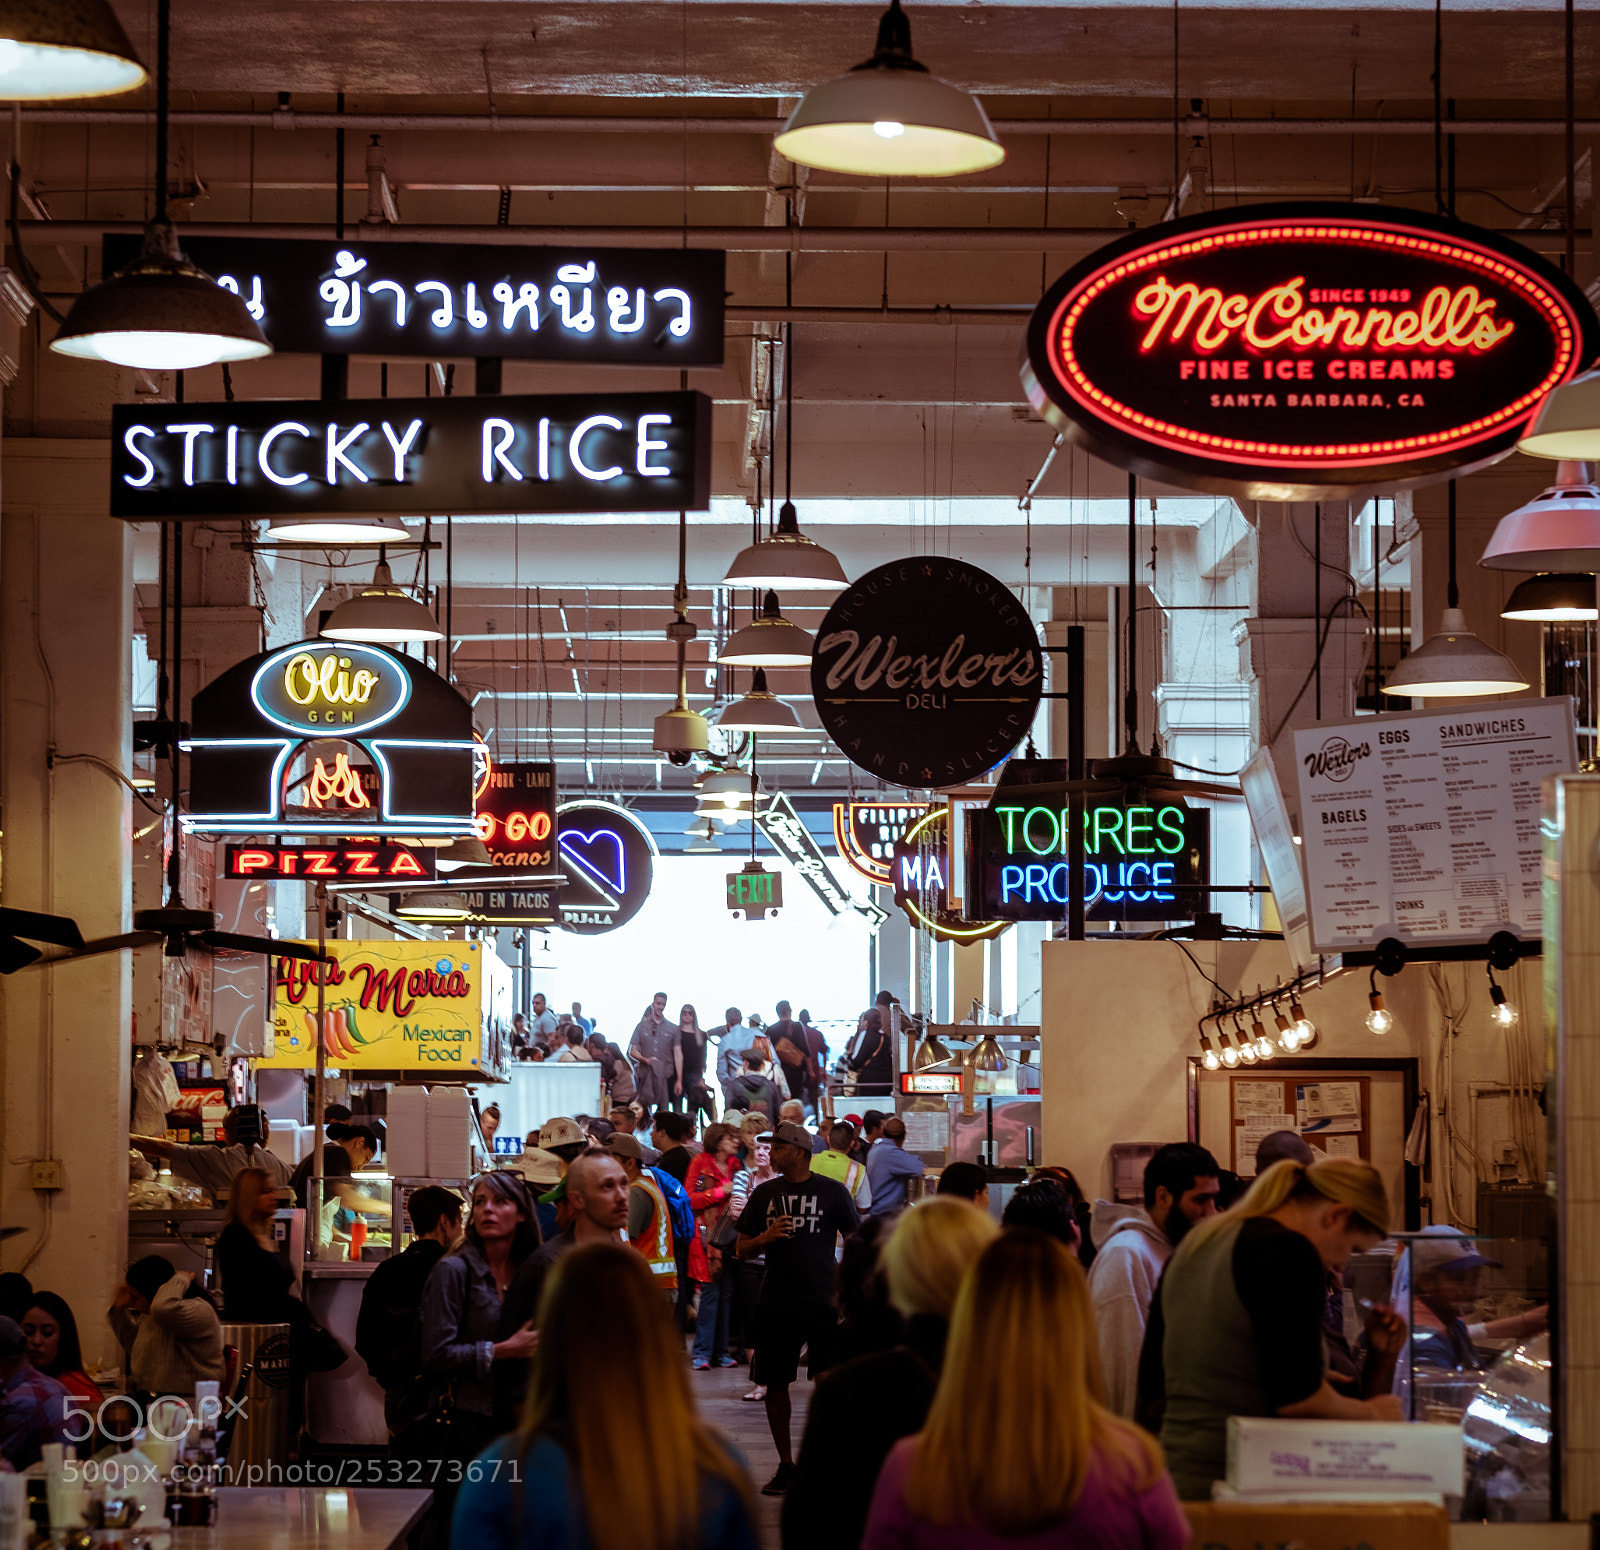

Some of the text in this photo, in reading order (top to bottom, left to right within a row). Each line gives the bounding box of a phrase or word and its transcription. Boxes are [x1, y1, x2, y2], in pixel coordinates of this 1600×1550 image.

[319, 250, 692, 337] ข้าวเหนียว
[1309, 288, 1411, 303] SINCE 1949
[1134, 275, 1515, 352] McConnell's
[1180, 359, 1455, 380] FINE ICE CREAMS
[1210, 394, 1425, 410] SANTA BARBARA, CA
[124, 414, 673, 487] STICKY RICE
[839, 568, 912, 622] HOUSE
[944, 568, 1019, 627] SMOKED
[285, 653, 379, 705] Olio
[906, 693, 947, 710] DELI
[1379, 730, 1410, 745] EGGS
[1440, 719, 1525, 739] SANDWICHES
[833, 714, 910, 775] HAND
[946, 713, 1020, 775] SLICED
[490, 772, 514, 788] PORK
[505, 811, 551, 841] GO
[1321, 808, 1367, 825] BAGELS
[232, 850, 428, 875] PIZZA
[490, 892, 506, 909] EN
[511, 892, 549, 909] TACOS
[735, 874, 774, 904] EXIT
[1395, 900, 1424, 910] DRINKS
[350, 962, 471, 1017] Maria
[403, 1024, 472, 1042] Mexican
[418, 1044, 462, 1061] Food
